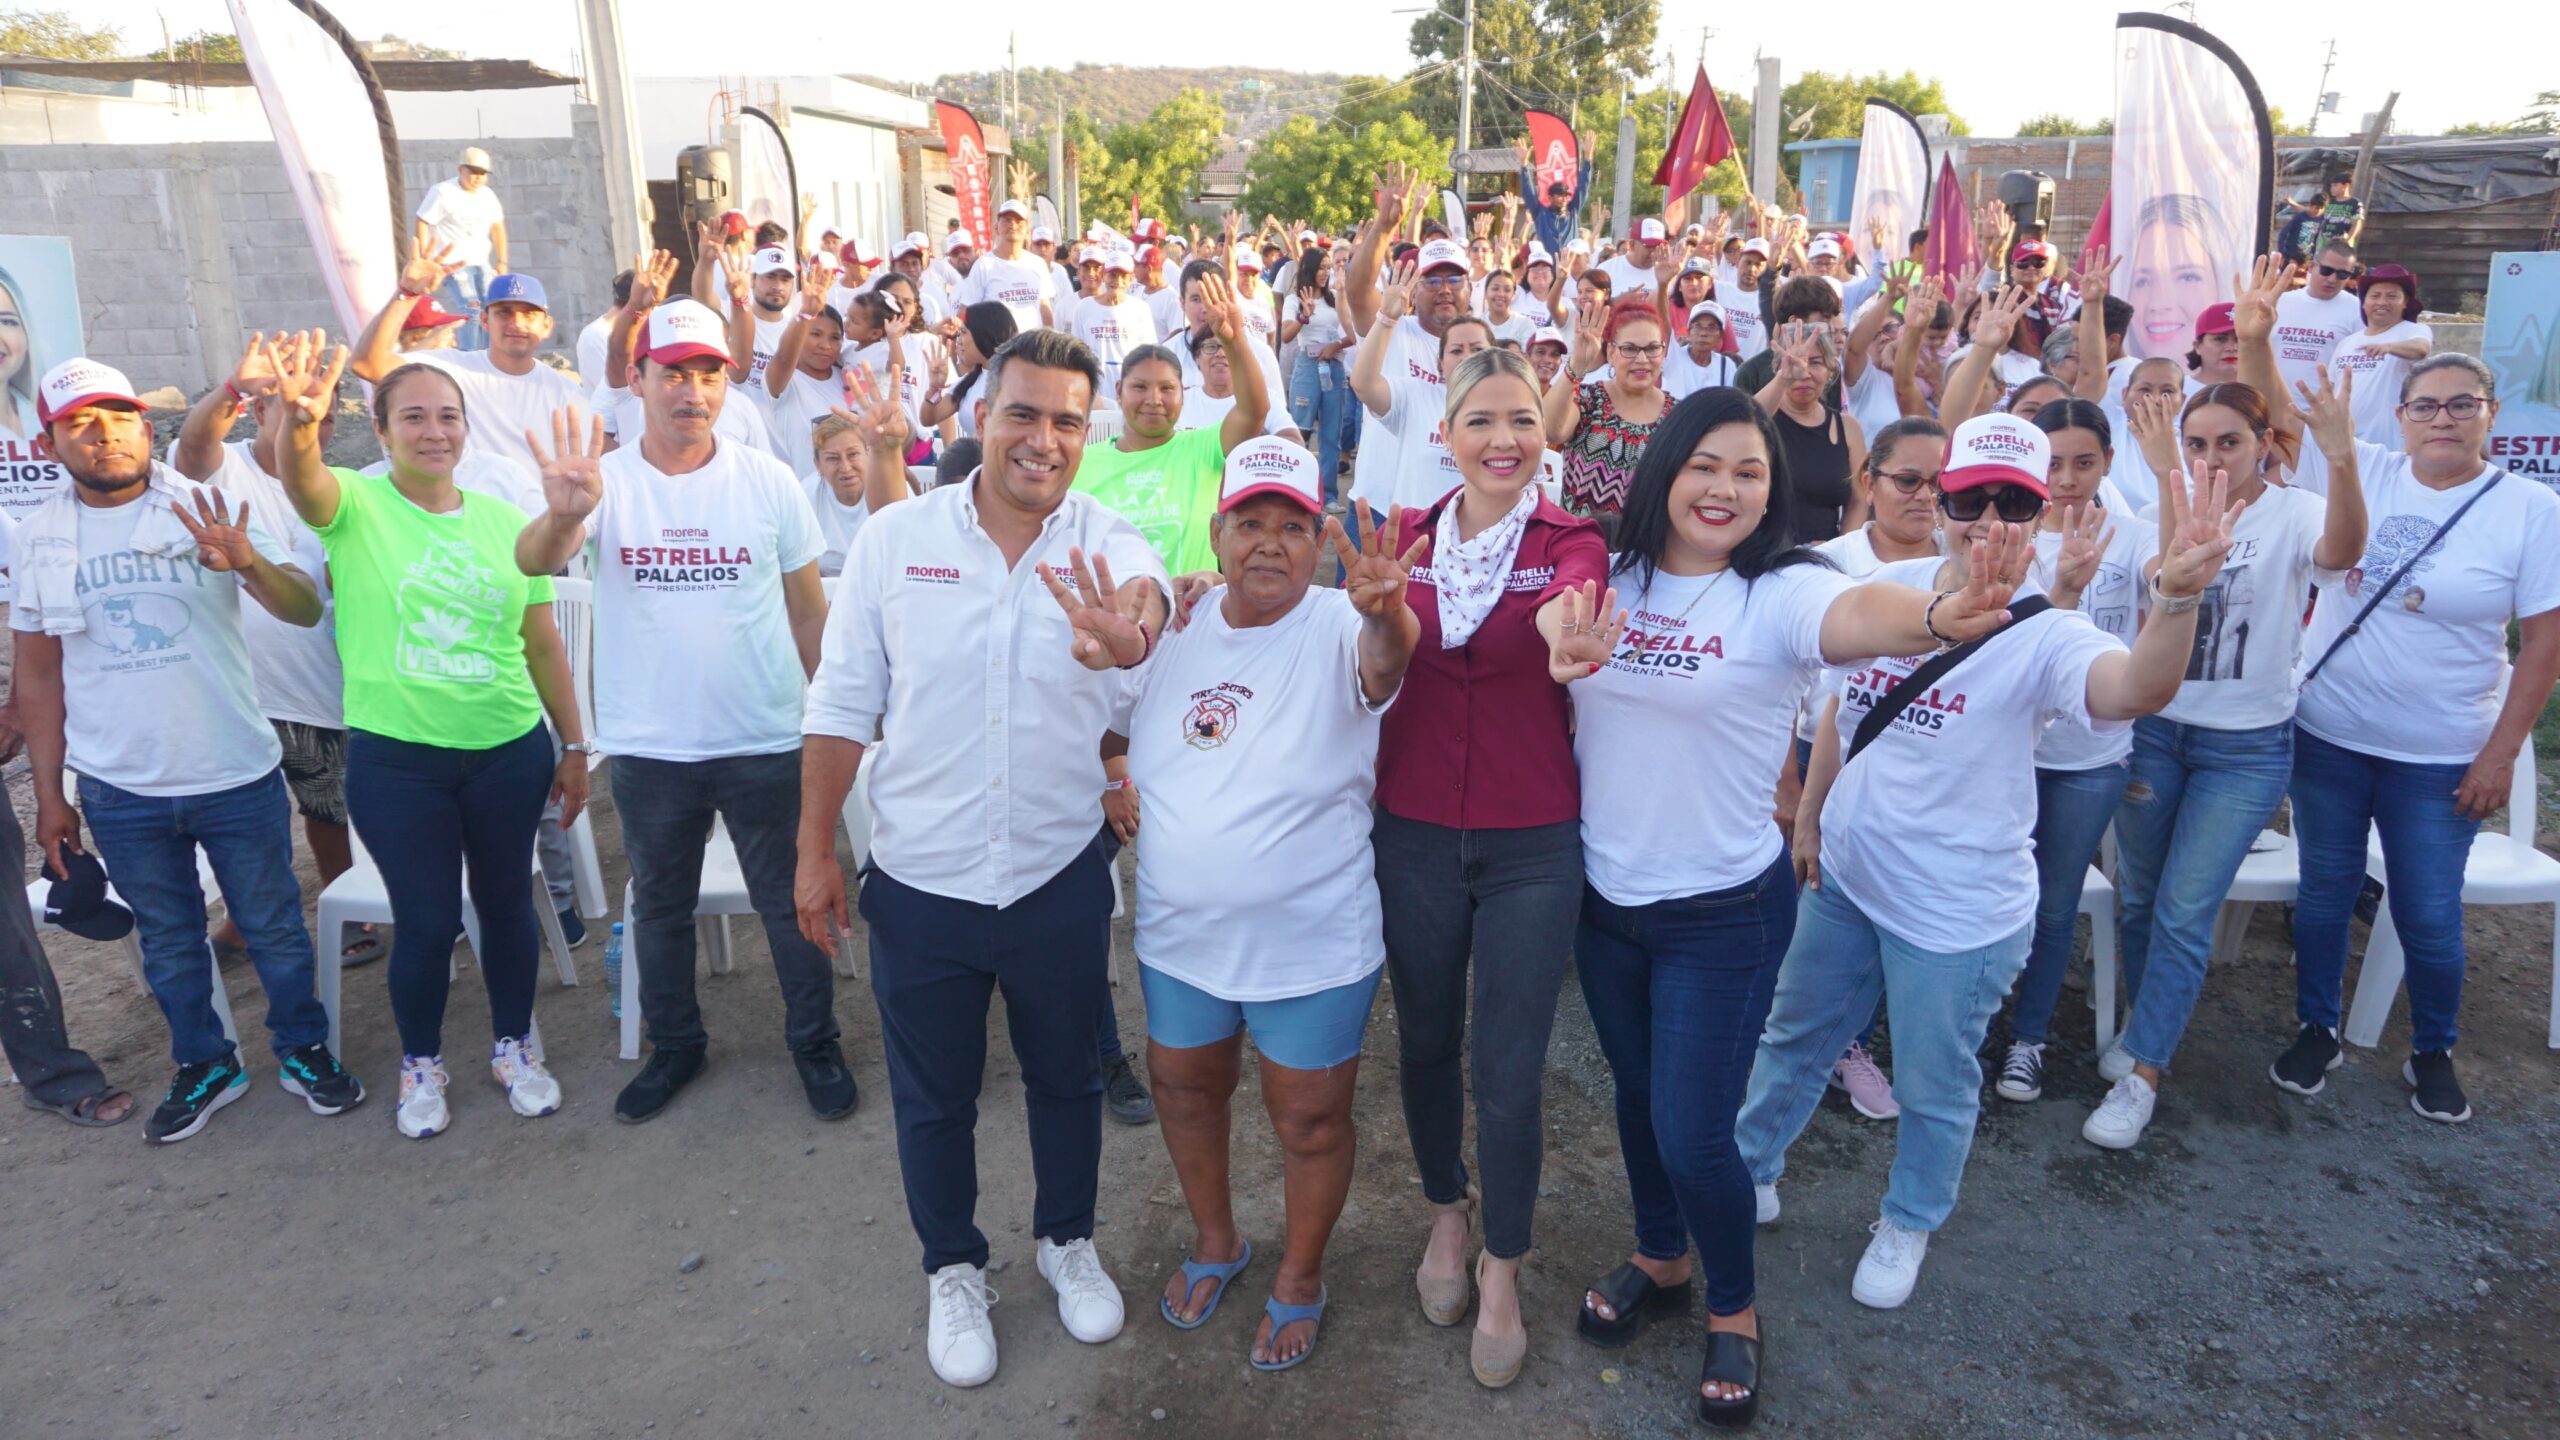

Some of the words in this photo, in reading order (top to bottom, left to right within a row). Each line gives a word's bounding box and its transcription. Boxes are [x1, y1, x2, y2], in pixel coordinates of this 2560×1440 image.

[2278, 327, 2335, 339] ESTRELLA
[2282, 335, 2326, 345] PALACIOS
[1968, 433, 2035, 452] ESTRELLA
[1975, 443, 2028, 456] PALACIOS
[1239, 452, 1300, 466] ESTRELLA
[1245, 460, 1294, 472] PALACIOS
[662, 528, 709, 538] morena
[620, 546, 752, 566] ESTRELLA
[75, 548, 204, 595] AUGHTY
[635, 567, 739, 582] PALACIOS
[906, 566, 960, 579] morena
[1409, 565, 1432, 579] ren
[1506, 565, 1555, 580] STRELLA
[407, 561, 429, 577] SE
[430, 571, 481, 598] PINTA
[483, 589, 508, 604] DE
[656, 584, 717, 592] PRESIDENTA
[1505, 575, 1551, 588] PALACIOS
[1634, 609, 1687, 628] morena
[135, 658, 158, 668] BEST
[159, 653, 191, 664] FRIEND
[405, 643, 490, 676] VERDE
[1606, 660, 1665, 677] ESIDENTA
